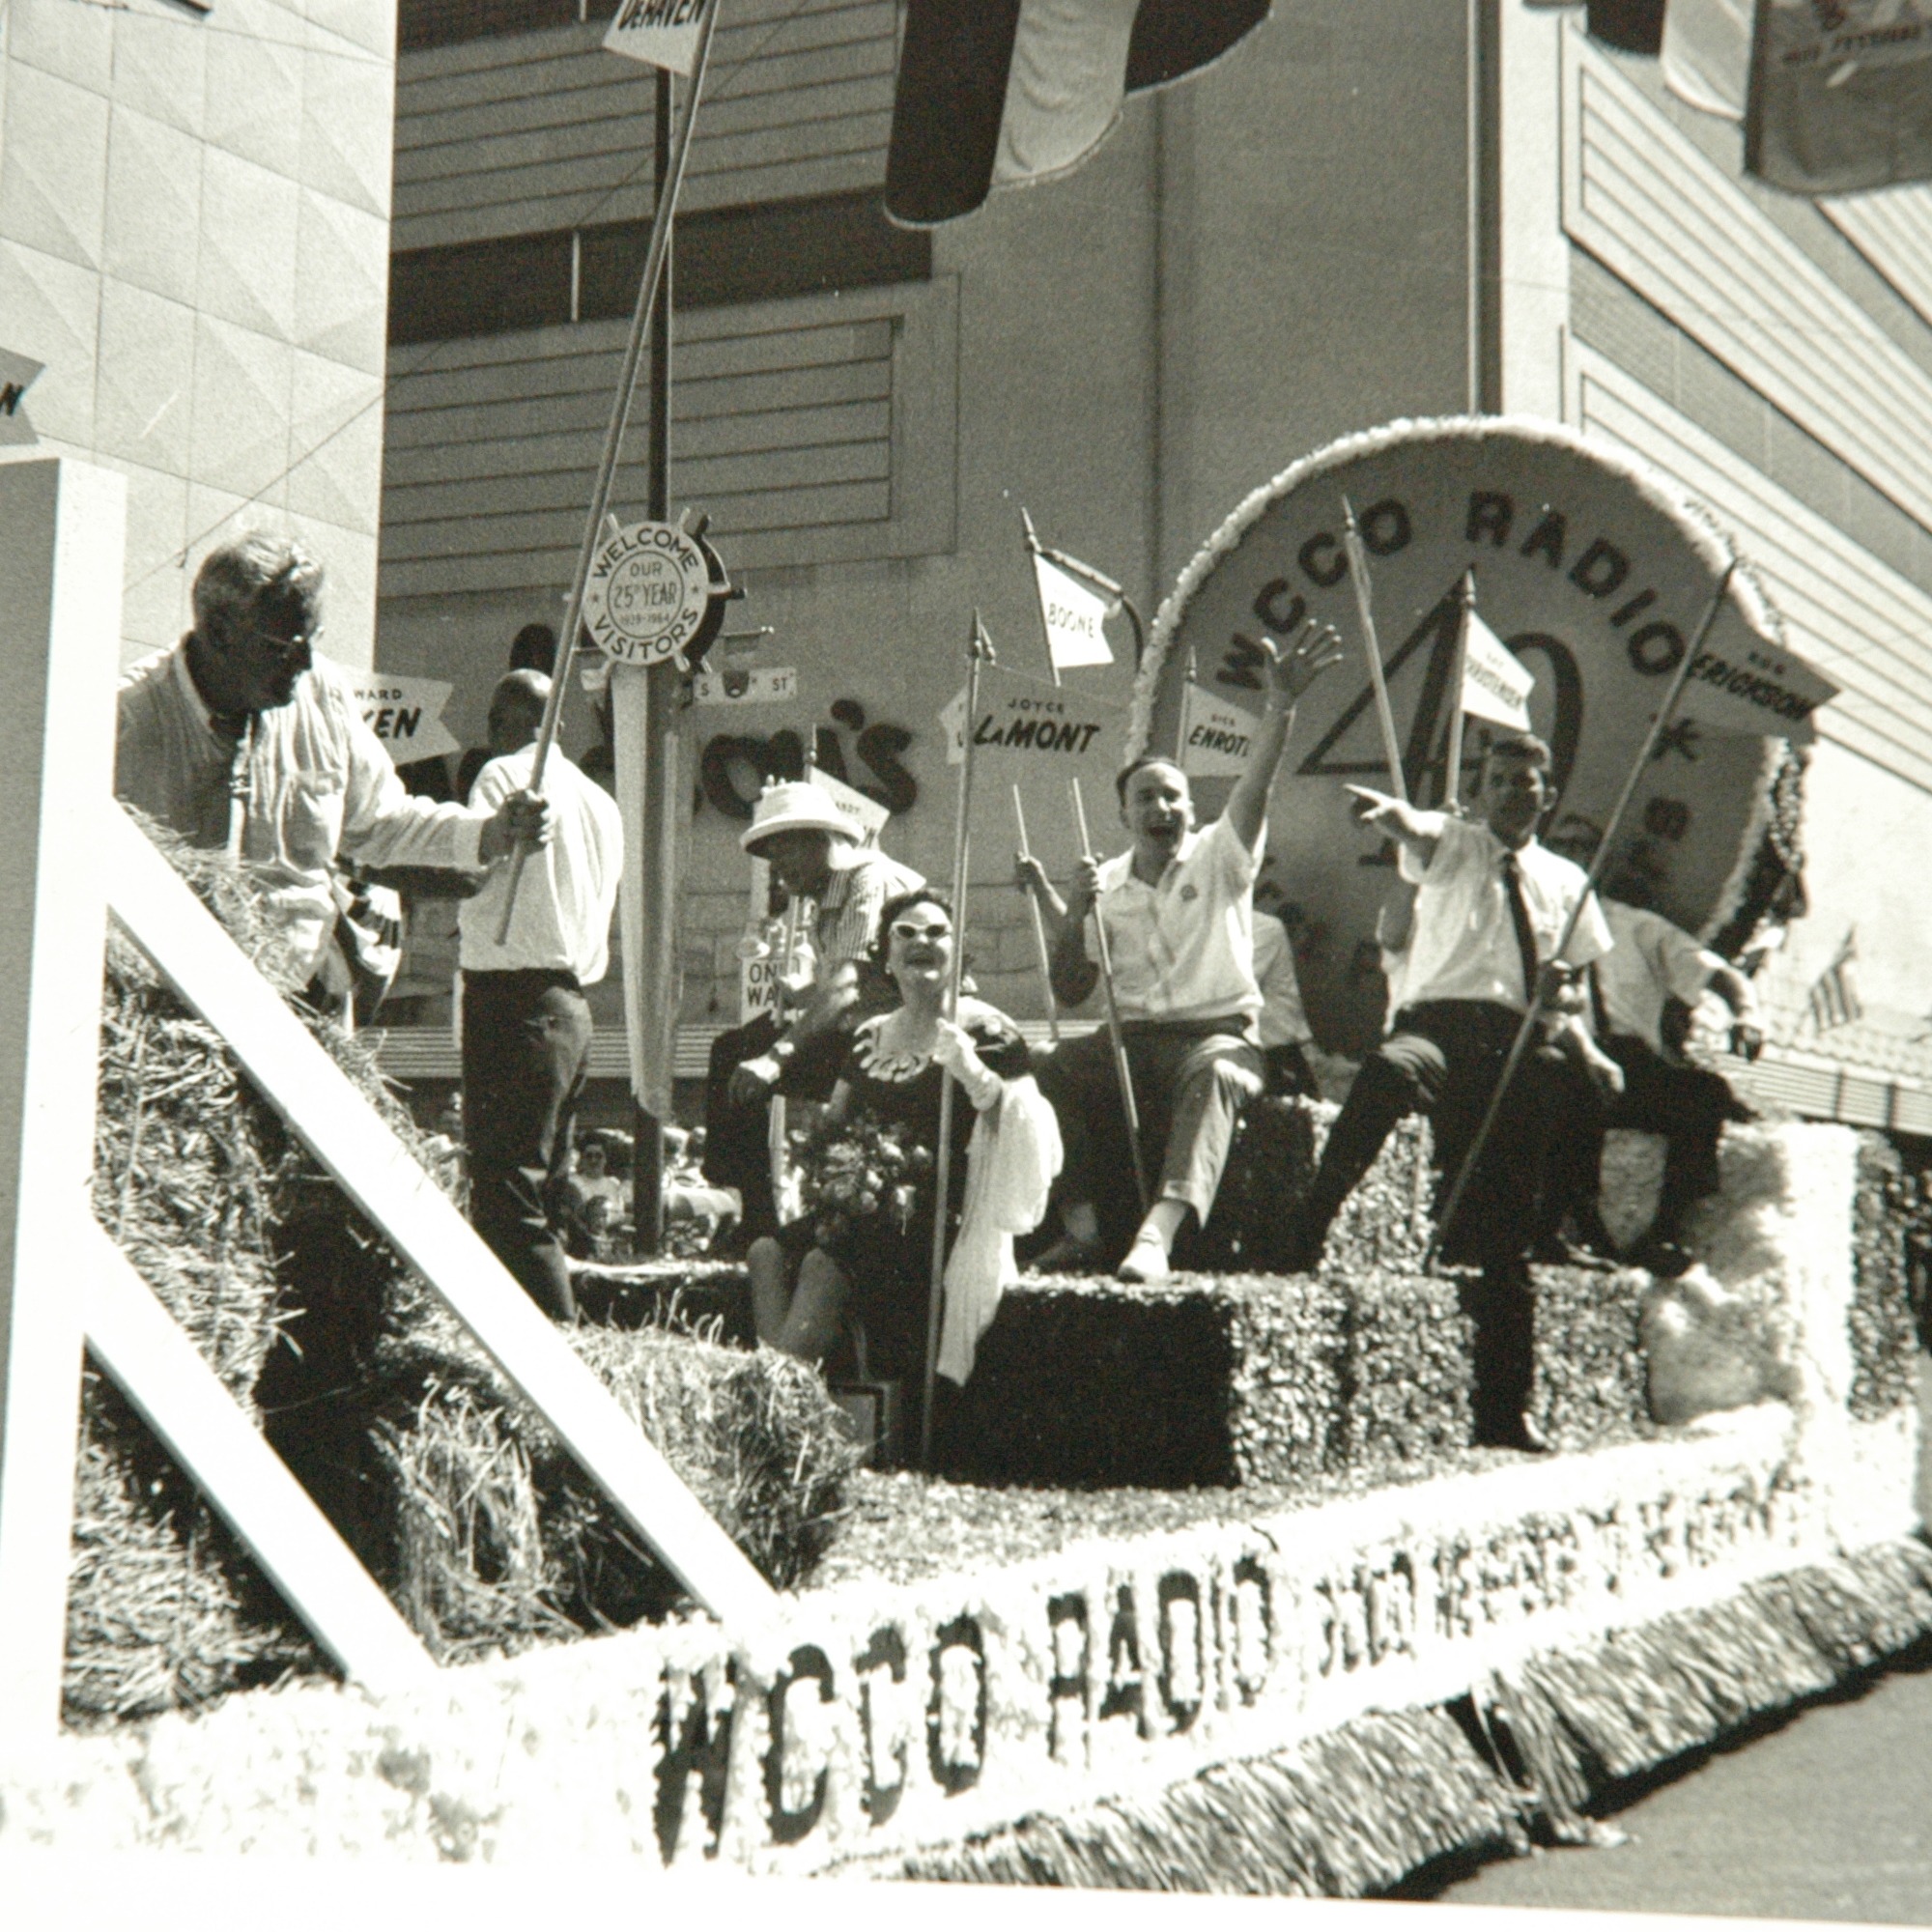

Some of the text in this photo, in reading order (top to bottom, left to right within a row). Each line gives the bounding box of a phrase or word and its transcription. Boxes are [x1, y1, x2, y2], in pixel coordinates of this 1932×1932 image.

[593, 527, 699, 579] WELCOME
[629, 561, 663, 578] OUR
[642, 582, 677, 607] YEAR
[1216, 492, 1686, 690] WCCO RADIO
[1048, 603, 1094, 639] BOONE
[594, 608, 698, 660] VISITORS
[354, 689, 403, 700] WARD
[773, 677, 787, 692] ST
[1008, 697, 1065, 714] JOYCE
[973, 714, 1100, 753] LaMONT
[749, 964, 778, 983] ON
[747, 986, 780, 1007] WA
[1046, 1551, 1272, 1768] RADIO
